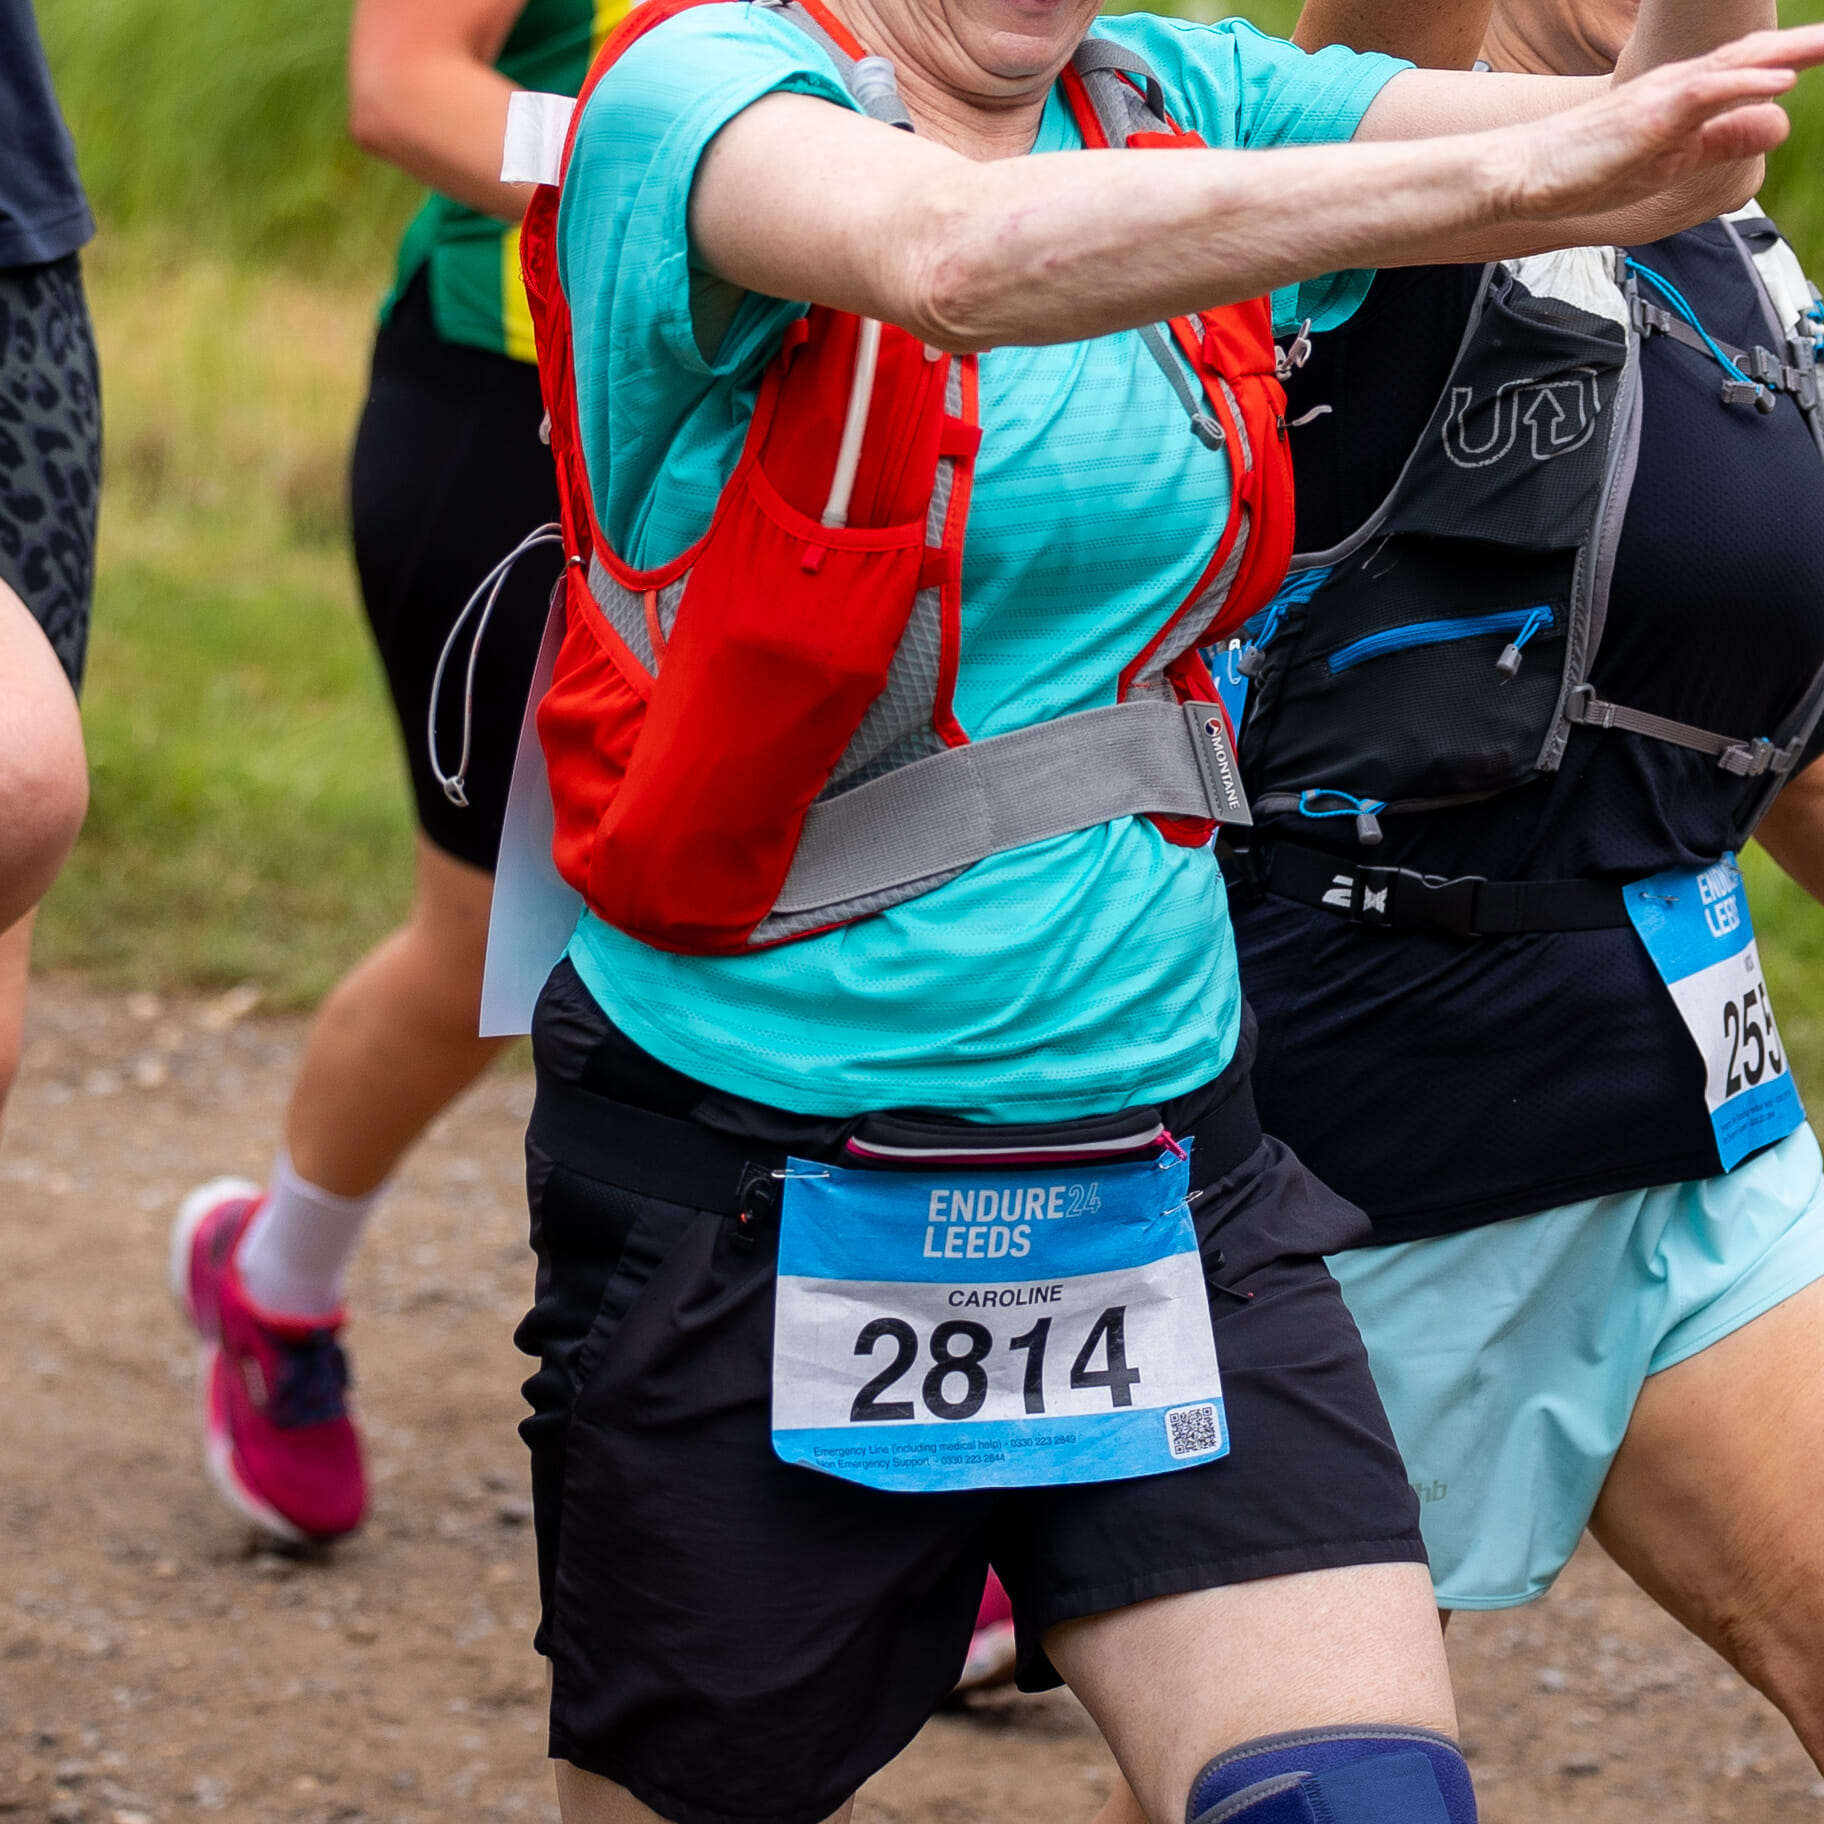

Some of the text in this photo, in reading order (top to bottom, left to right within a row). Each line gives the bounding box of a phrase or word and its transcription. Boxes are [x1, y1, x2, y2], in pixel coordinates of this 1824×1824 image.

[1211, 736, 1240, 810] MONTANE
[923, 1224, 1032, 1259] LEEDS
[948, 1285, 1064, 1308] CAROLINE
[849, 1305, 1141, 1422] 2814
[813, 1445, 866, 1457] Emergency
[868, 1445, 889, 1455] Line
[891, 1442, 937, 1454] (including
[939, 1440, 976, 1451] medical
[978, 1439, 1002, 1451] help)
[1010, 1437, 1033, 1448] 0330
[1036, 1436, 1052, 1446] 223
[838, 1458, 890, 1470] Emergency
[892, 1456, 930, 1469] Support
[940, 1455, 963, 1465] 0330
[965, 1454, 982, 1464] 223
